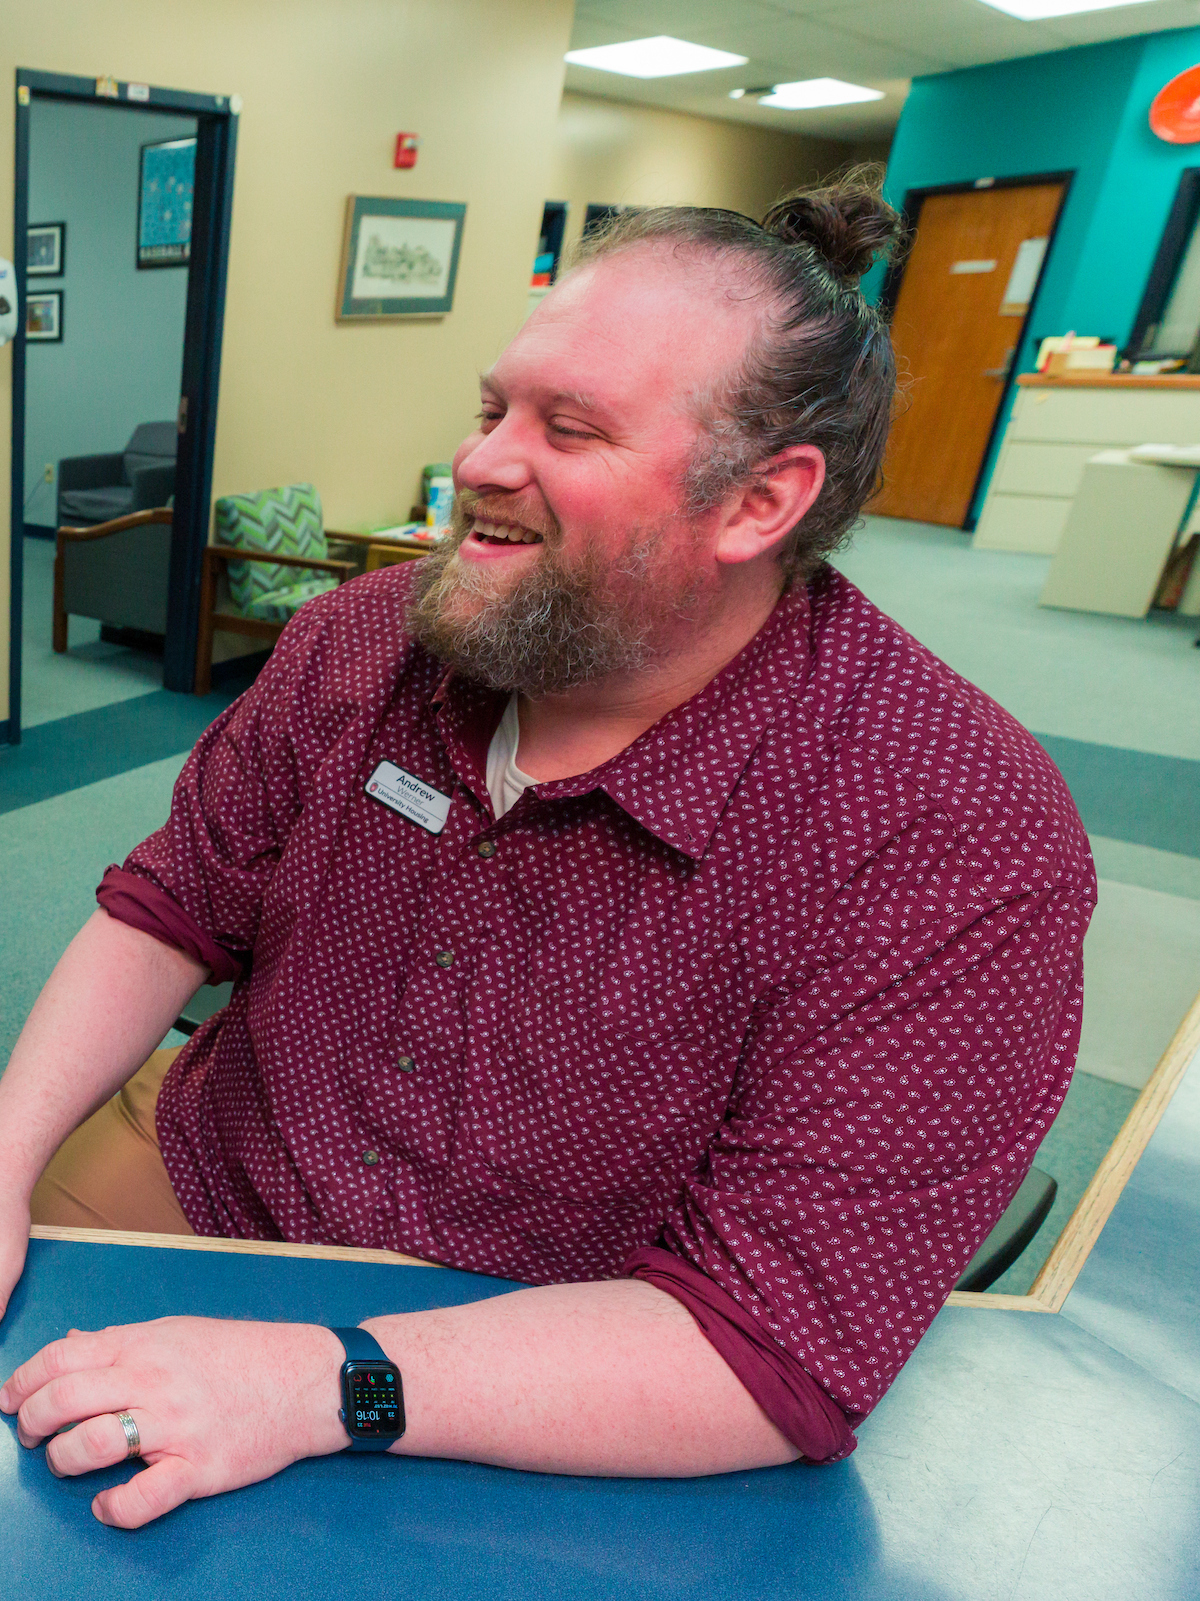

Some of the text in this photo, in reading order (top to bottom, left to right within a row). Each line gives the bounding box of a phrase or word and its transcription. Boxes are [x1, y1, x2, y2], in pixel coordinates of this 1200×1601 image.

[396, 775, 436, 802] Andrew
[397, 785, 425, 806] Werner
[377, 787, 430, 824] University Housing
[356, 1410, 380, 1421] 10:16
